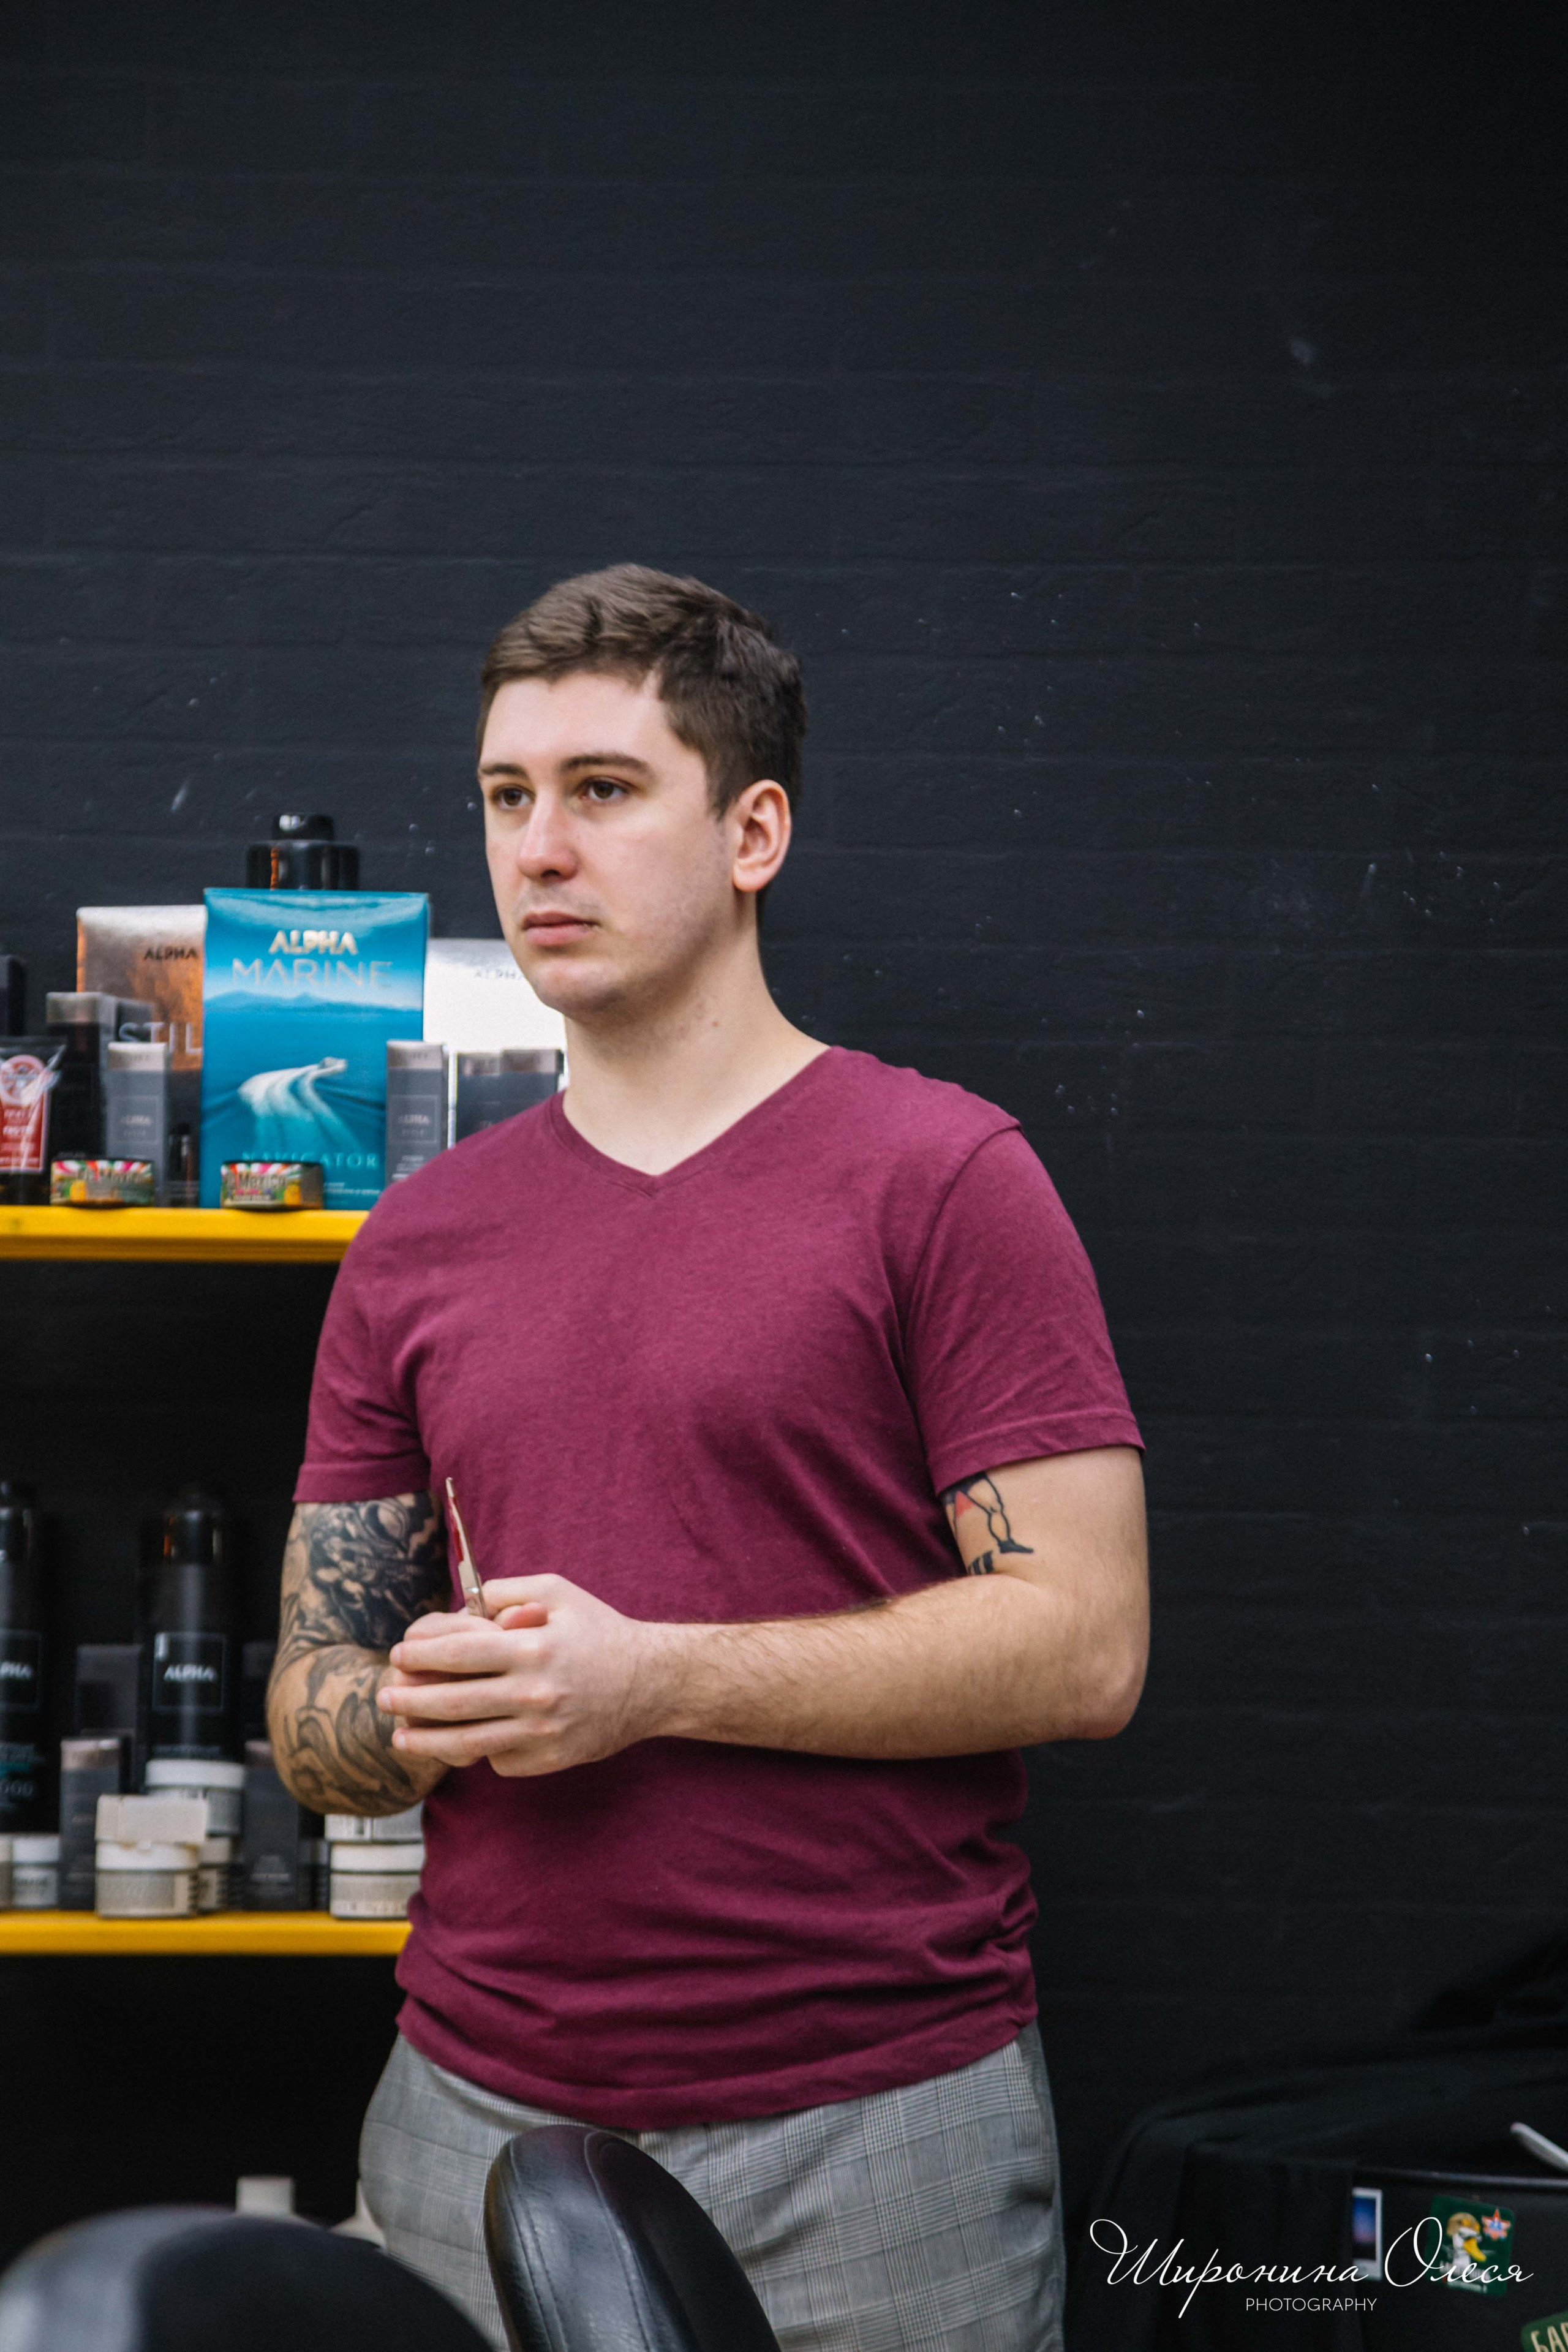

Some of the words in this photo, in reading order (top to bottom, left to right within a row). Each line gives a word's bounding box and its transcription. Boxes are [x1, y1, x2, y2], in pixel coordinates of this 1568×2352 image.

[268, 930, 358, 955] ALPHA
[144, 947, 197, 960] ALPHA
[232, 958, 393, 989] MARINE
[164, 1664, 217, 1682] ALPHA
